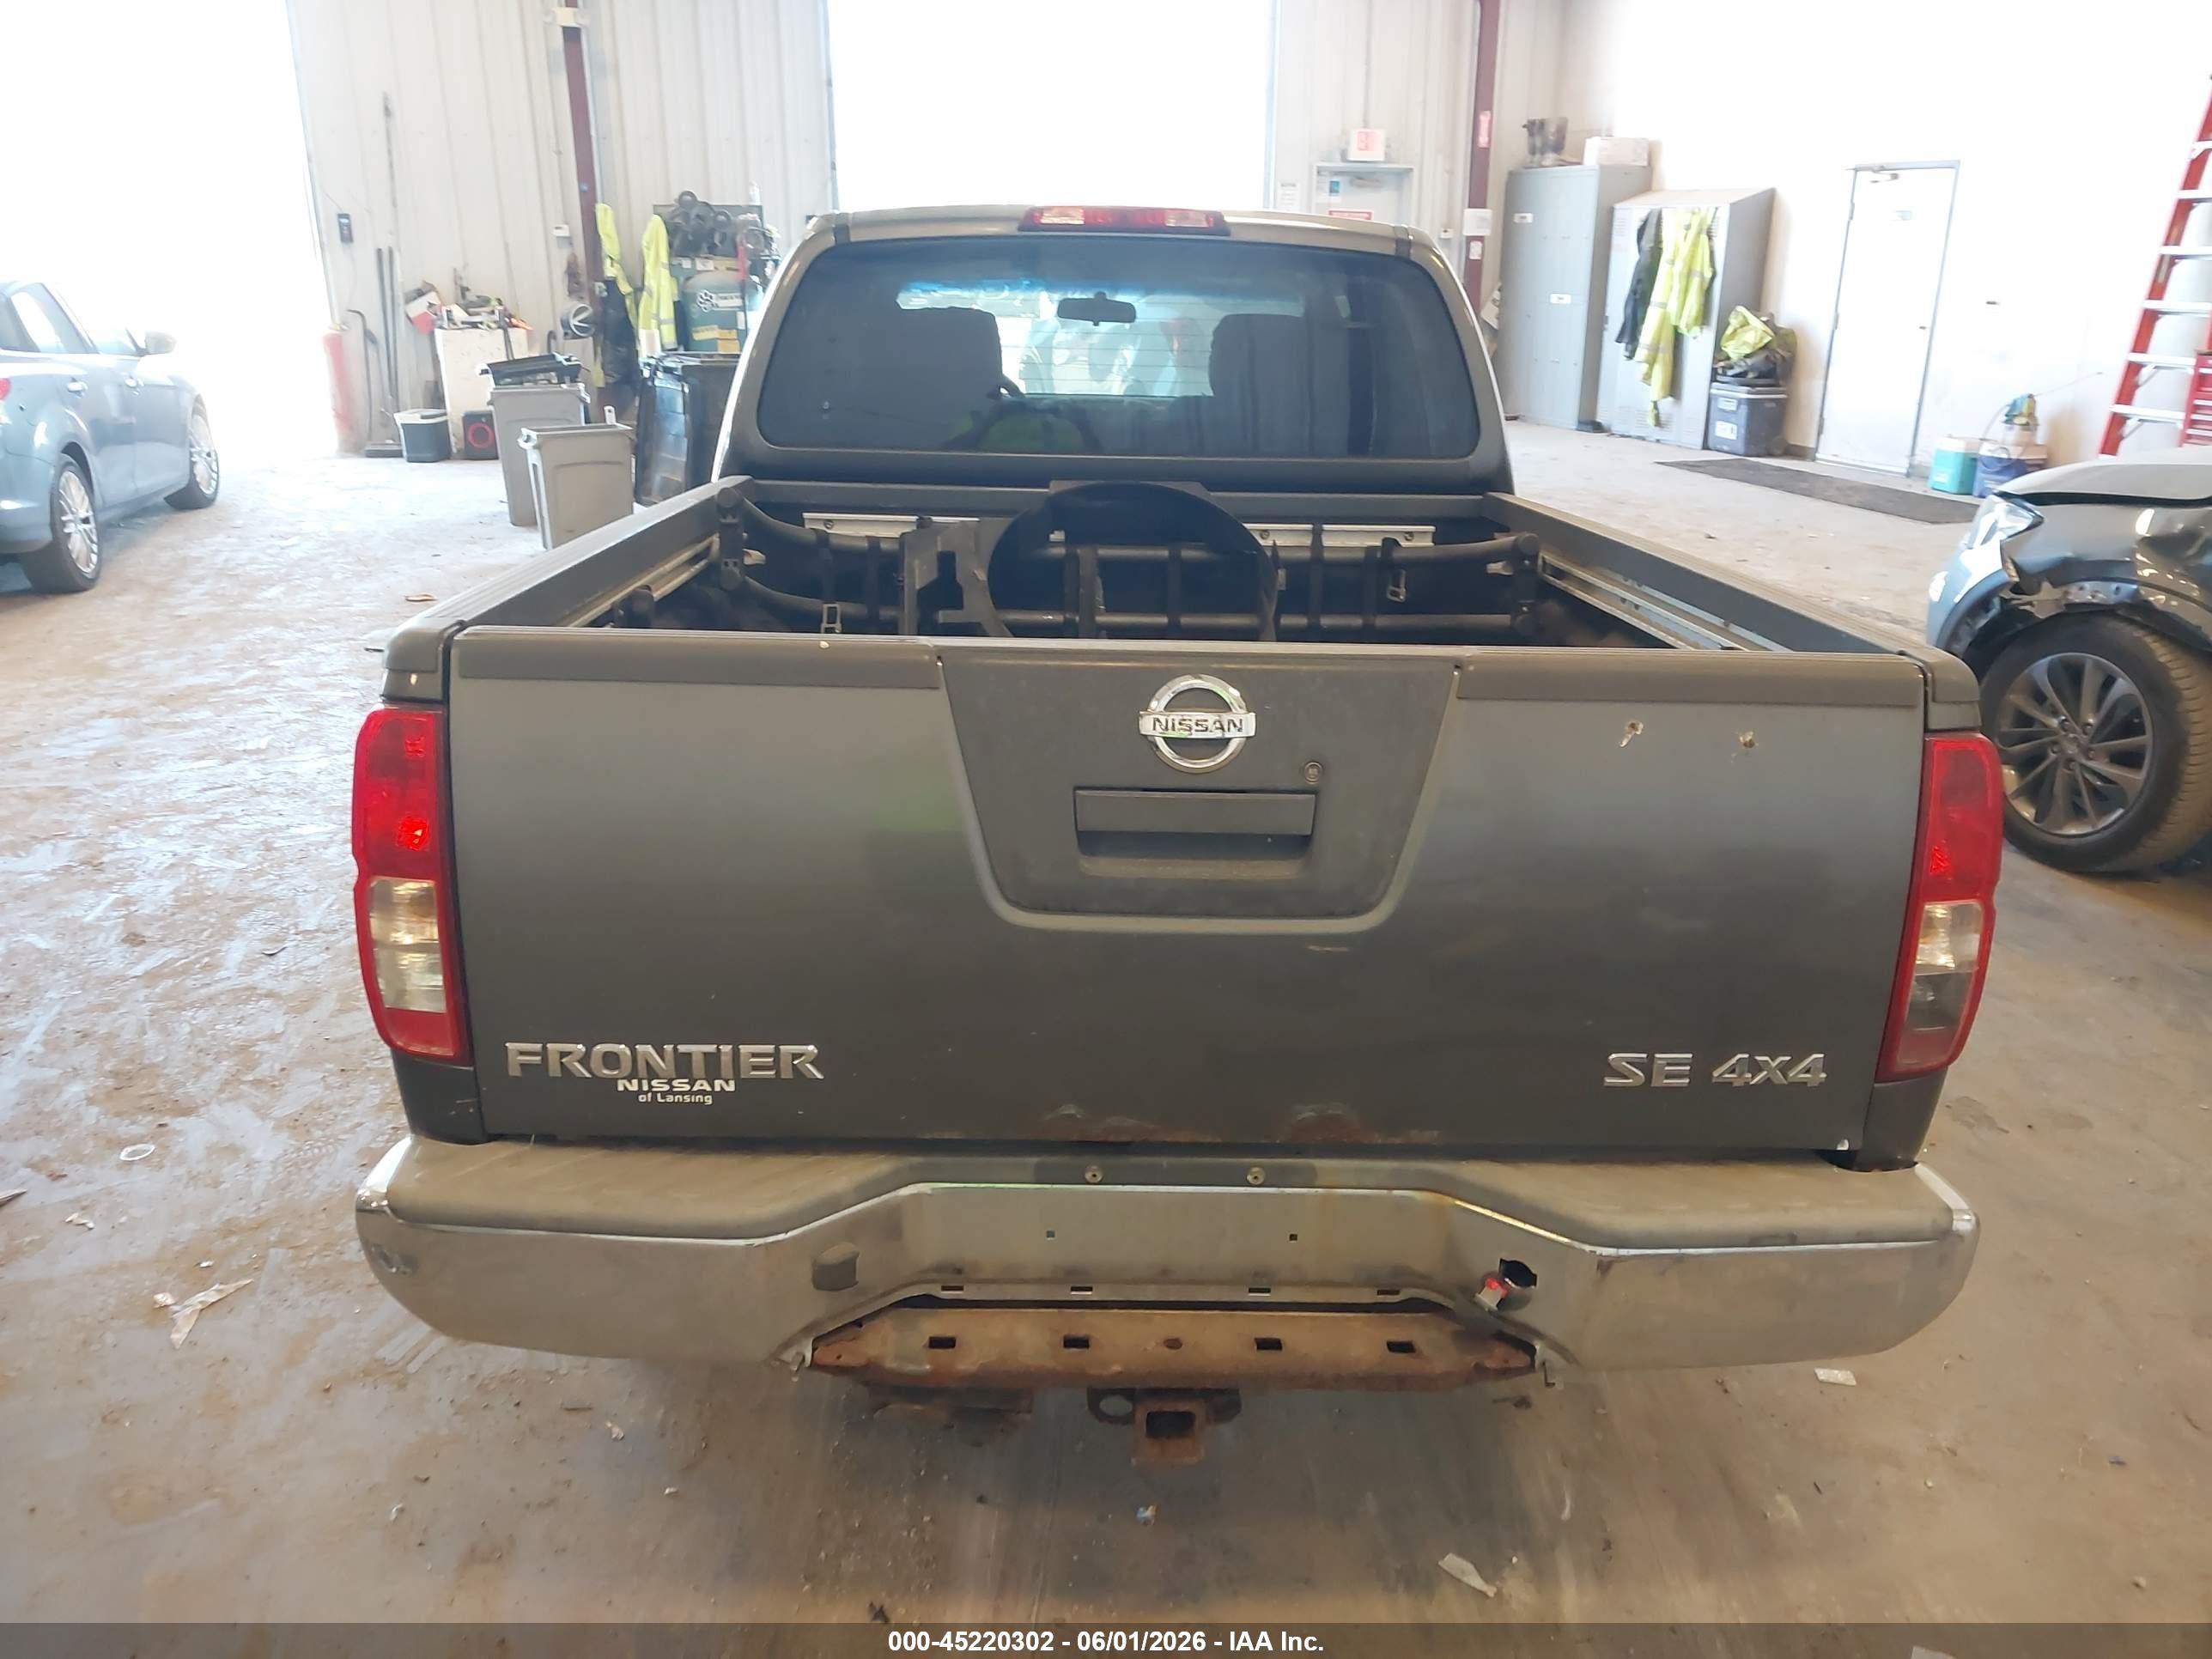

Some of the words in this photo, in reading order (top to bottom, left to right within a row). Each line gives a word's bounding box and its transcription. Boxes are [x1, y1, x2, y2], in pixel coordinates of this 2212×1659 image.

[1152, 717, 1244, 732] NISSAN
[504, 1042, 824, 1079] FRONTIER
[1603, 1053, 1693, 1087] SE
[617, 1079, 736, 1091] NISSAN
[638, 1092, 652, 1103] of
[657, 1092, 713, 1105] Lansing
